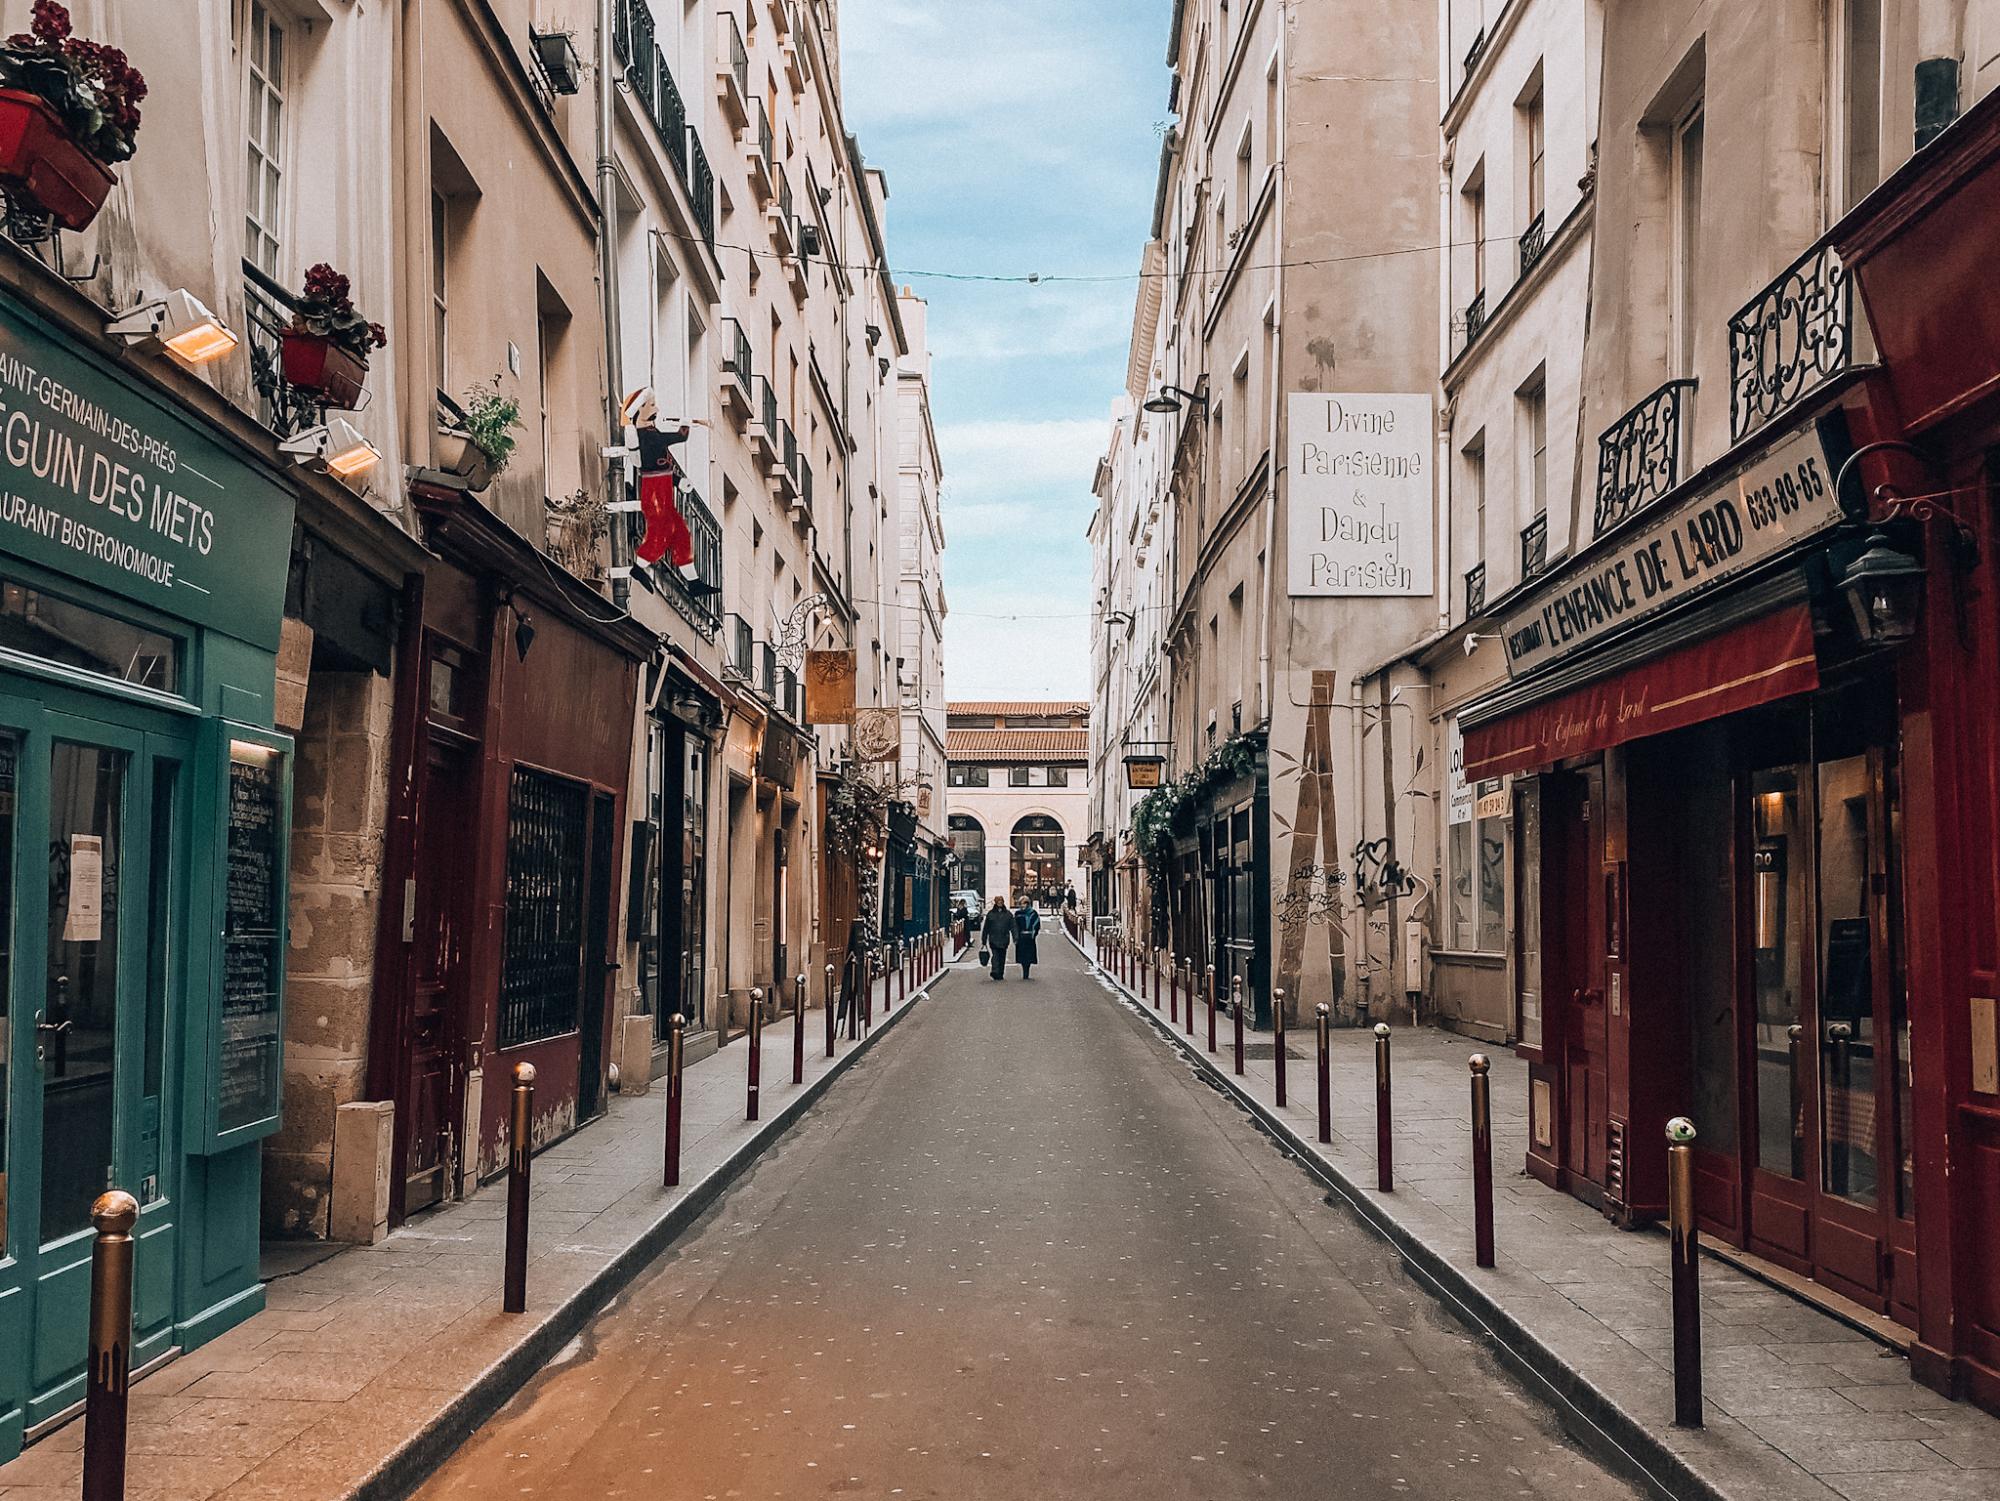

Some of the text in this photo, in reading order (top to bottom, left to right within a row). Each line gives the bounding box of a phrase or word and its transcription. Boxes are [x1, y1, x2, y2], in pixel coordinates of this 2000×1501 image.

[1326, 399, 1395, 436] Divine
[0, 390, 214, 556] GUIN DES METS
[1300, 442, 1421, 479] Parisienne
[1352, 488, 1367, 508] &
[0, 491, 175, 588] URANT BISTRONOMIQUE
[1320, 502, 1400, 564] Dandy
[1542, 558, 1636, 648] L'ENFANCE
[1633, 539, 1673, 600] DE
[1671, 499, 1744, 580] LARD
[1745, 456, 1824, 531] 633-89-65
[1309, 552, 1412, 590] Parisien
